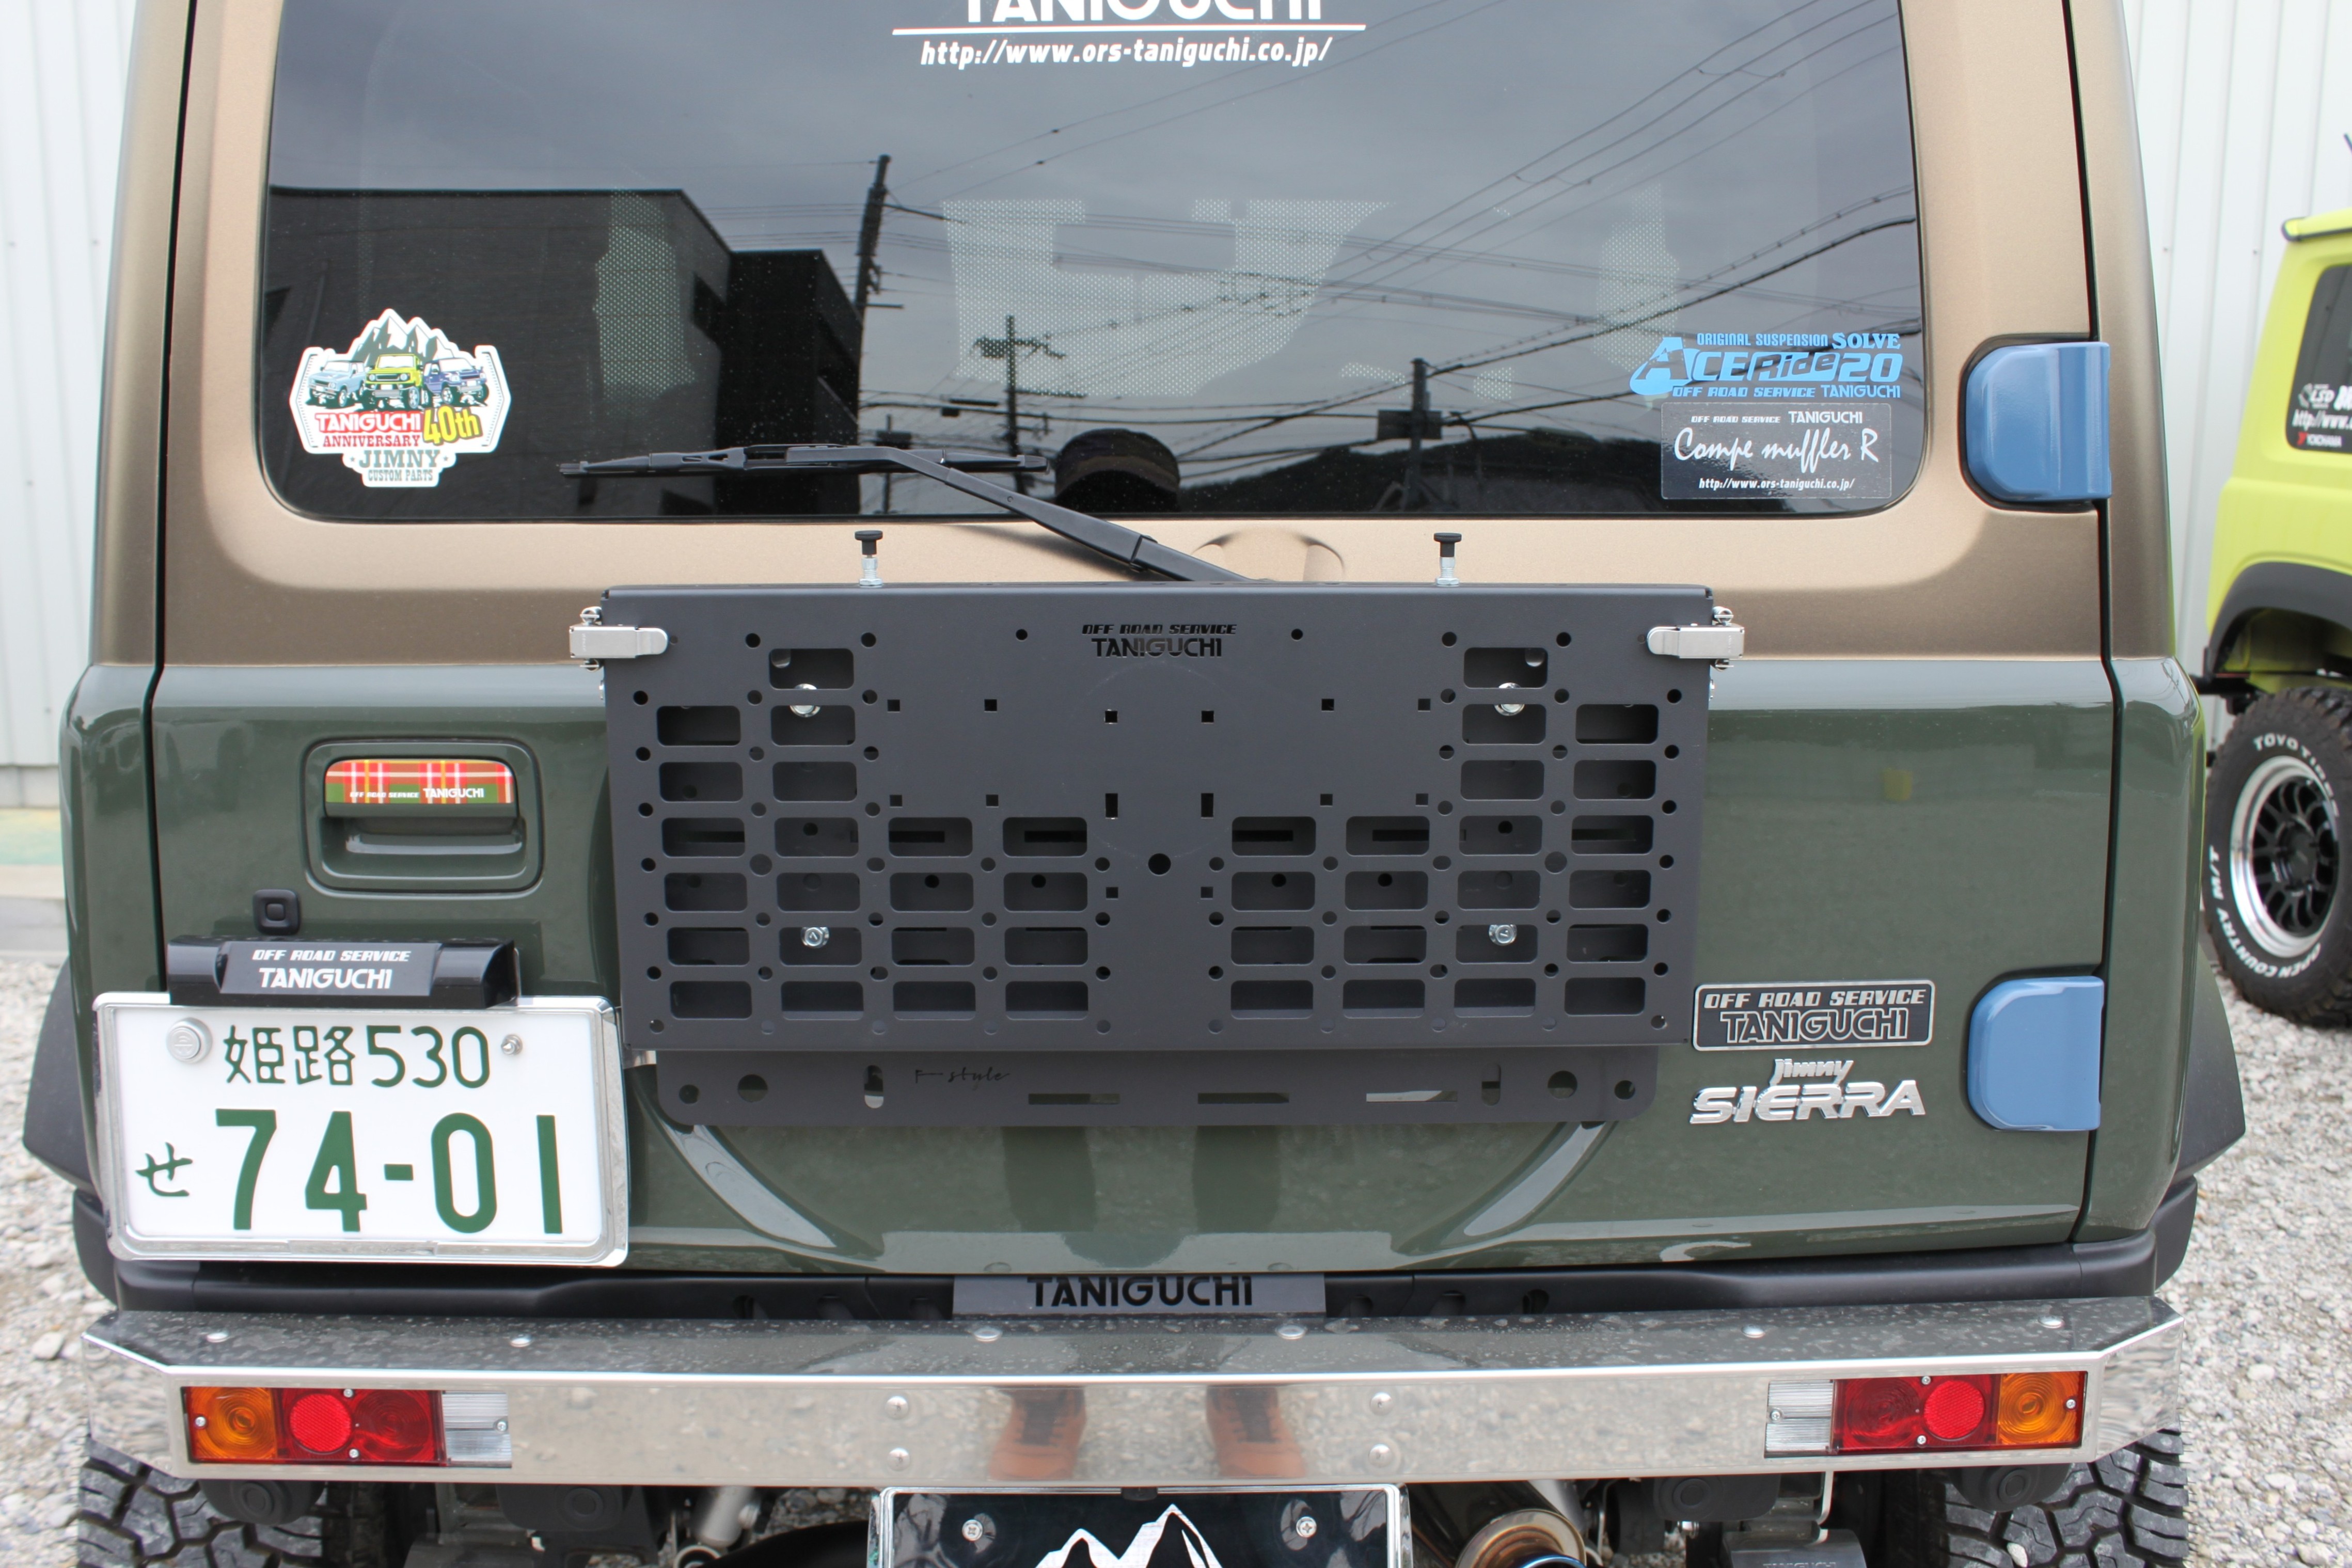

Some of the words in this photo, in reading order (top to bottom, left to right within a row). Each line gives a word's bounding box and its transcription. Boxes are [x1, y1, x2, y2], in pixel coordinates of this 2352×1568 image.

[921, 37, 1333, 70] http://www.ors-taniguchi.co.jp/
[1697, 333, 1751, 345] ORIGINAL
[1756, 333, 1828, 346] SUSPENSION
[1832, 332, 1901, 349] SOLVE
[1672, 387, 1703, 397] OFF
[1707, 387, 1748, 397] ROAD
[1754, 387, 1816, 398] SERVICE
[1821, 385, 1901, 398] TANIGUCHI
[2309, 389, 2335, 403] LSD
[315, 412, 422, 433] TANIGUCHI
[423, 405, 481, 445] 40th
[1788, 411, 1863, 424] TANIGUCHI
[323, 435, 420, 447] ANNIVERSARY
[1674, 427, 1753, 471] Compe
[1761, 428, 1851, 473] muffler
[1860, 428, 1879, 462] R
[358, 450, 440, 468] JIMNY
[368, 469, 402, 481] CUSTOM
[405, 469, 433, 481] PARTS
[1699, 478, 1855, 491] http://www.ors-taniguchi.co.jp/
[1082, 624, 1114, 635] OFF
[1119, 624, 1163, 635] ROAD
[1169, 624, 1237, 635] SERVICE
[1091, 638, 1222, 658] TANIGUCHI
[2253, 733, 2299, 751] TOYO
[422, 787, 484, 799] TANIGUCHI
[2216, 907, 2278, 977] COUNTRY
[252, 949, 287, 960] OFF
[290, 949, 336, 961] ROAD
[340, 949, 412, 962] SERVICE
[258, 967, 393, 989] TANIGUCHI
[1704, 993, 1751, 1009] OFF
[1758, 991, 1822, 1008] ROAD
[1829, 989, 1927, 1006] SERVICE
[1720, 1007, 1909, 1044] TANIGUCHI
[1689, 1080, 1926, 1124] SIERRA
[135, 1141, 193, 1198] せ
[215, 1108, 563, 1234] 74-01
[1027, 1275, 1253, 1307] TANIGUCHI
